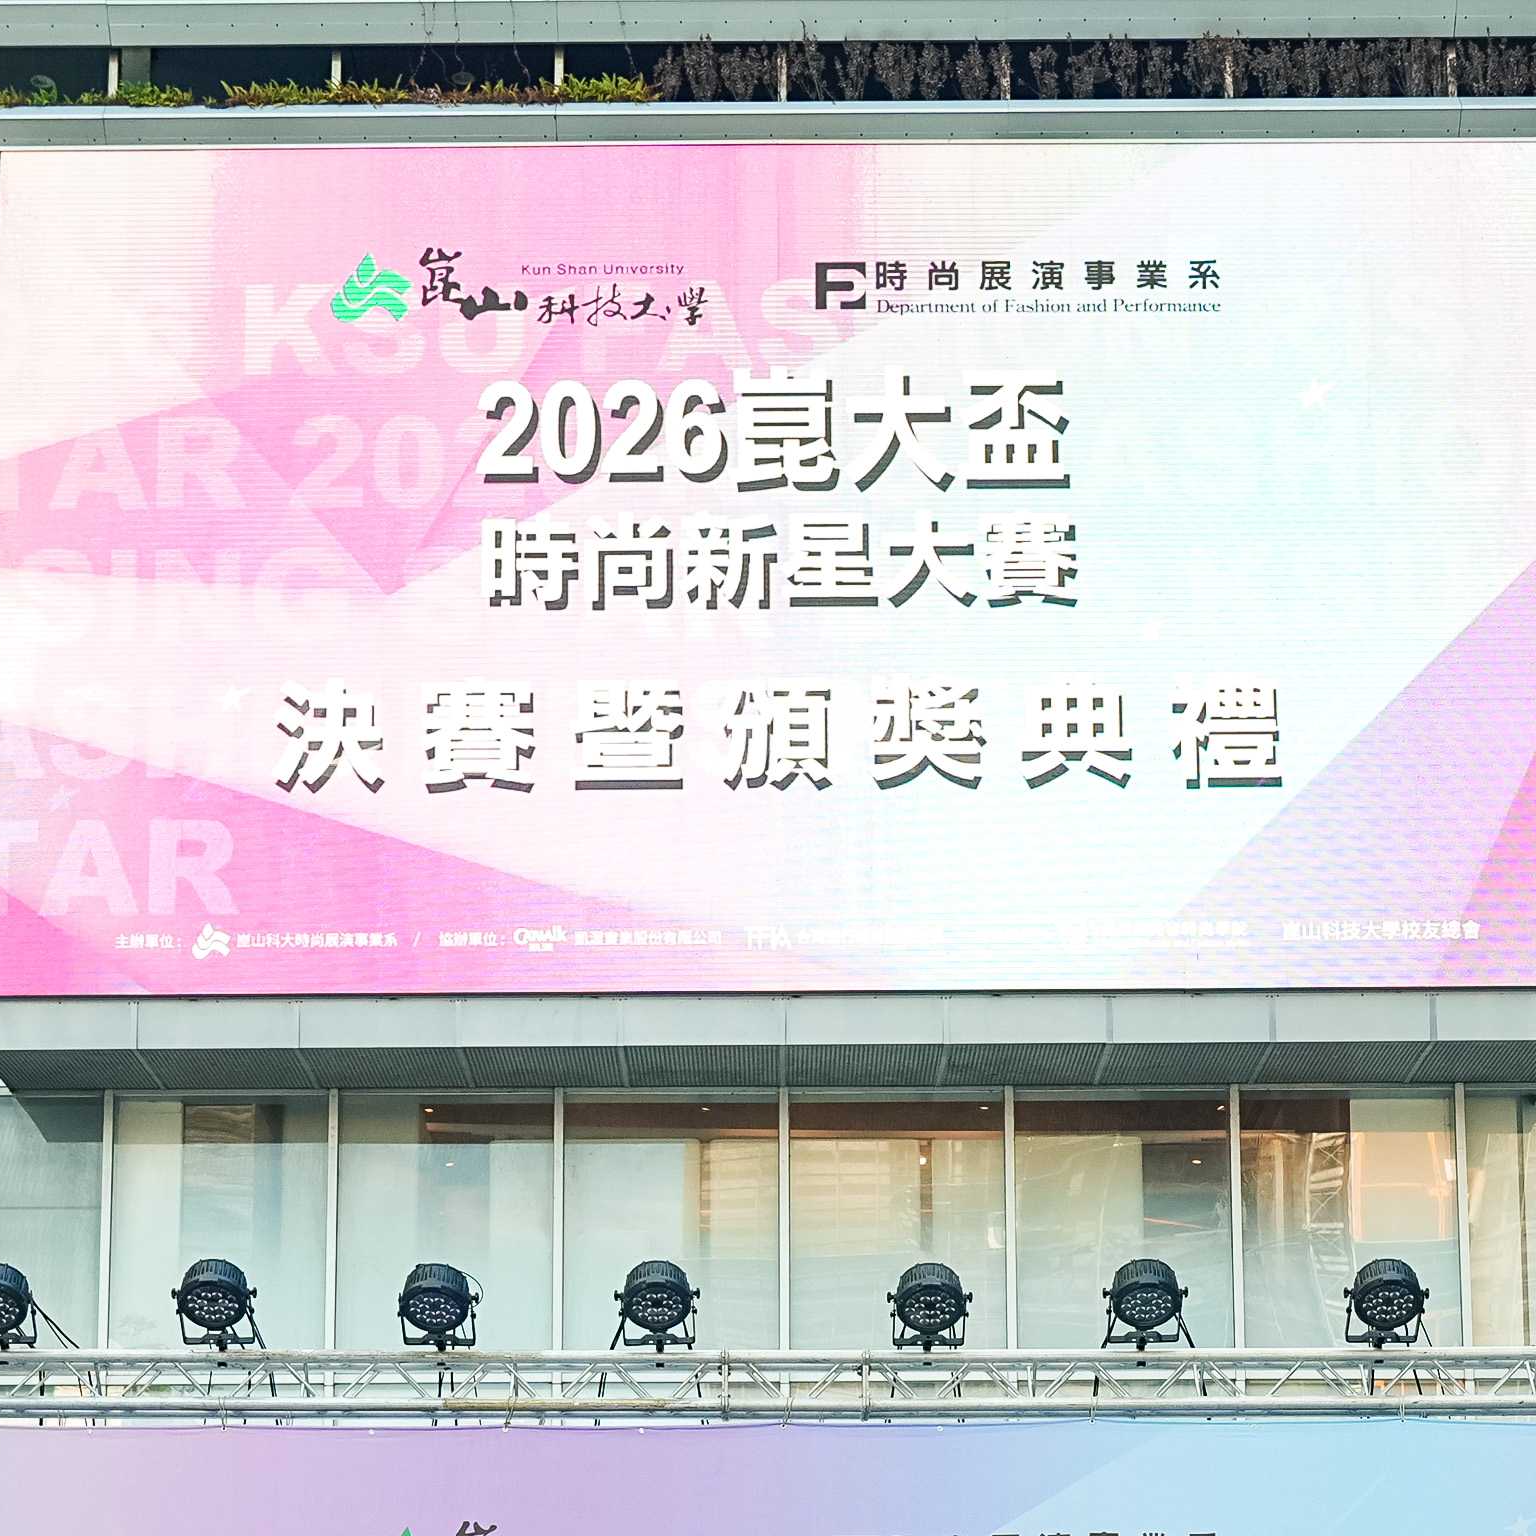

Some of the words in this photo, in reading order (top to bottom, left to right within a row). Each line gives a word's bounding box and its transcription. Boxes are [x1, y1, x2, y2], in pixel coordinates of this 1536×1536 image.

[522, 263, 551, 277] Kun
[558, 263, 597, 277] Shan
[603, 263, 684, 278] University
[876, 261, 1221, 291] 時尚展演事業系
[877, 299, 976, 316] Department
[983, 299, 999, 313] of
[1005, 299, 1071, 314] Fashion
[1077, 299, 1107, 314] and
[1113, 299, 1221, 314] Performance
[476, 366, 1070, 494] 2026崑大盃
[483, 513, 1077, 612] 時尚新星大賽
[273, 677, 1282, 793] 決賽暨頒獎典禮
